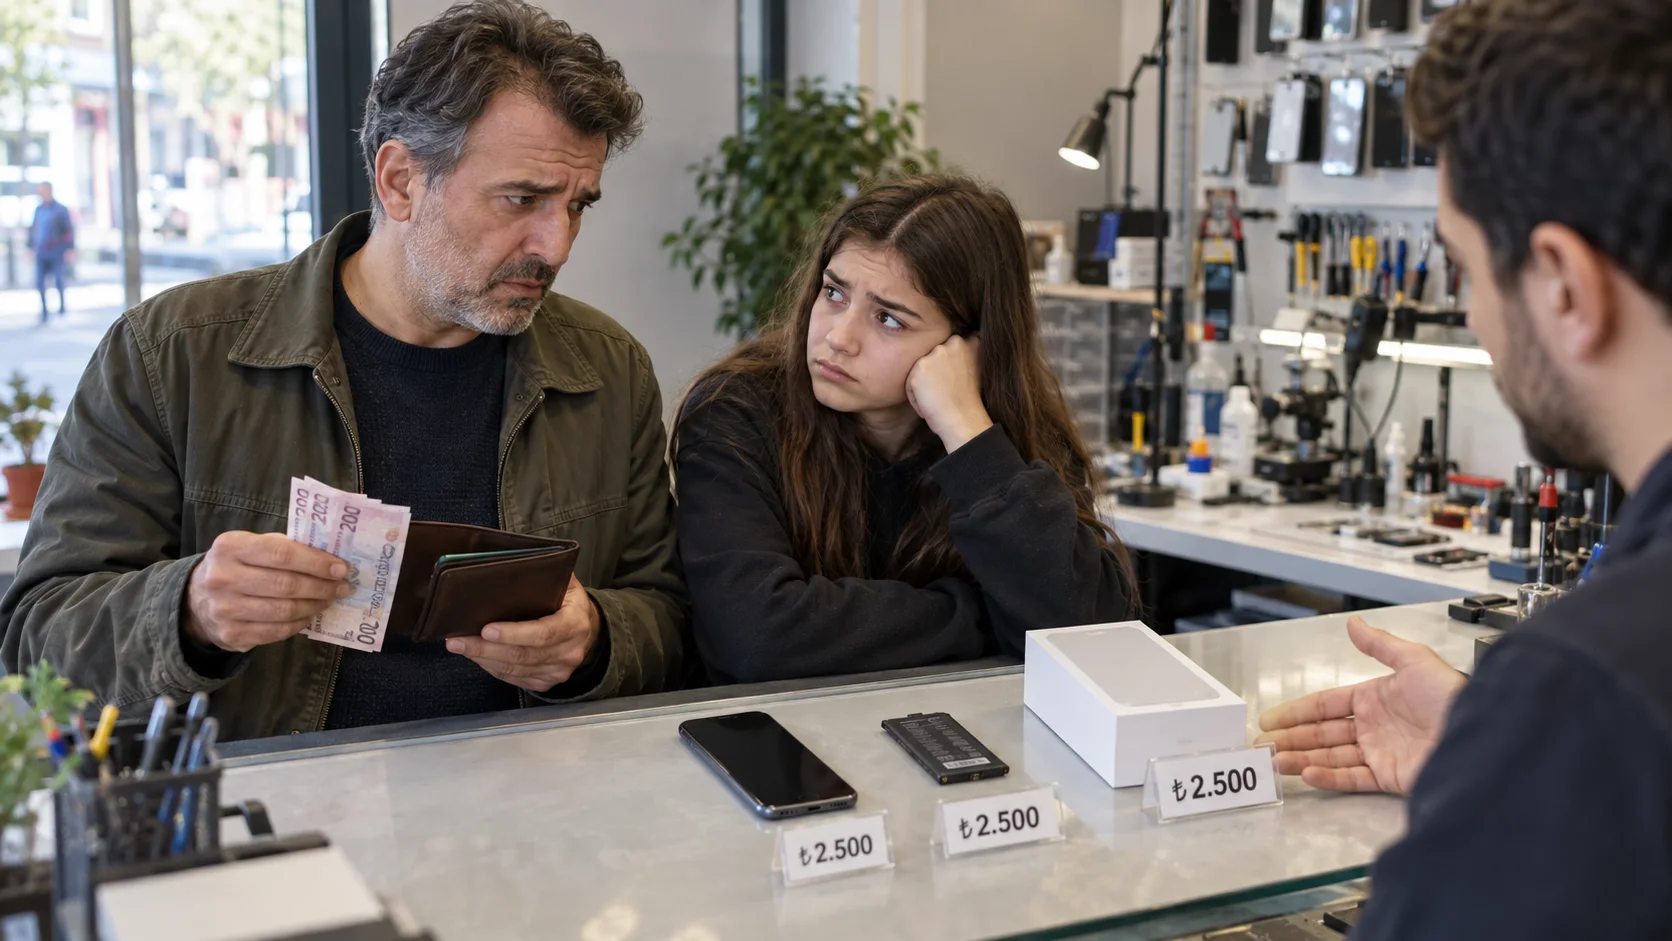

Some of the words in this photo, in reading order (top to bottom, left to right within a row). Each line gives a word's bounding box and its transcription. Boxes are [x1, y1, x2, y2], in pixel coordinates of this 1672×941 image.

[339, 505, 361, 533] 200
[1171, 766, 1257, 802] ₺2.500
[958, 806, 1040, 839] ₺2.500
[799, 834, 873, 867] ₺2.500
